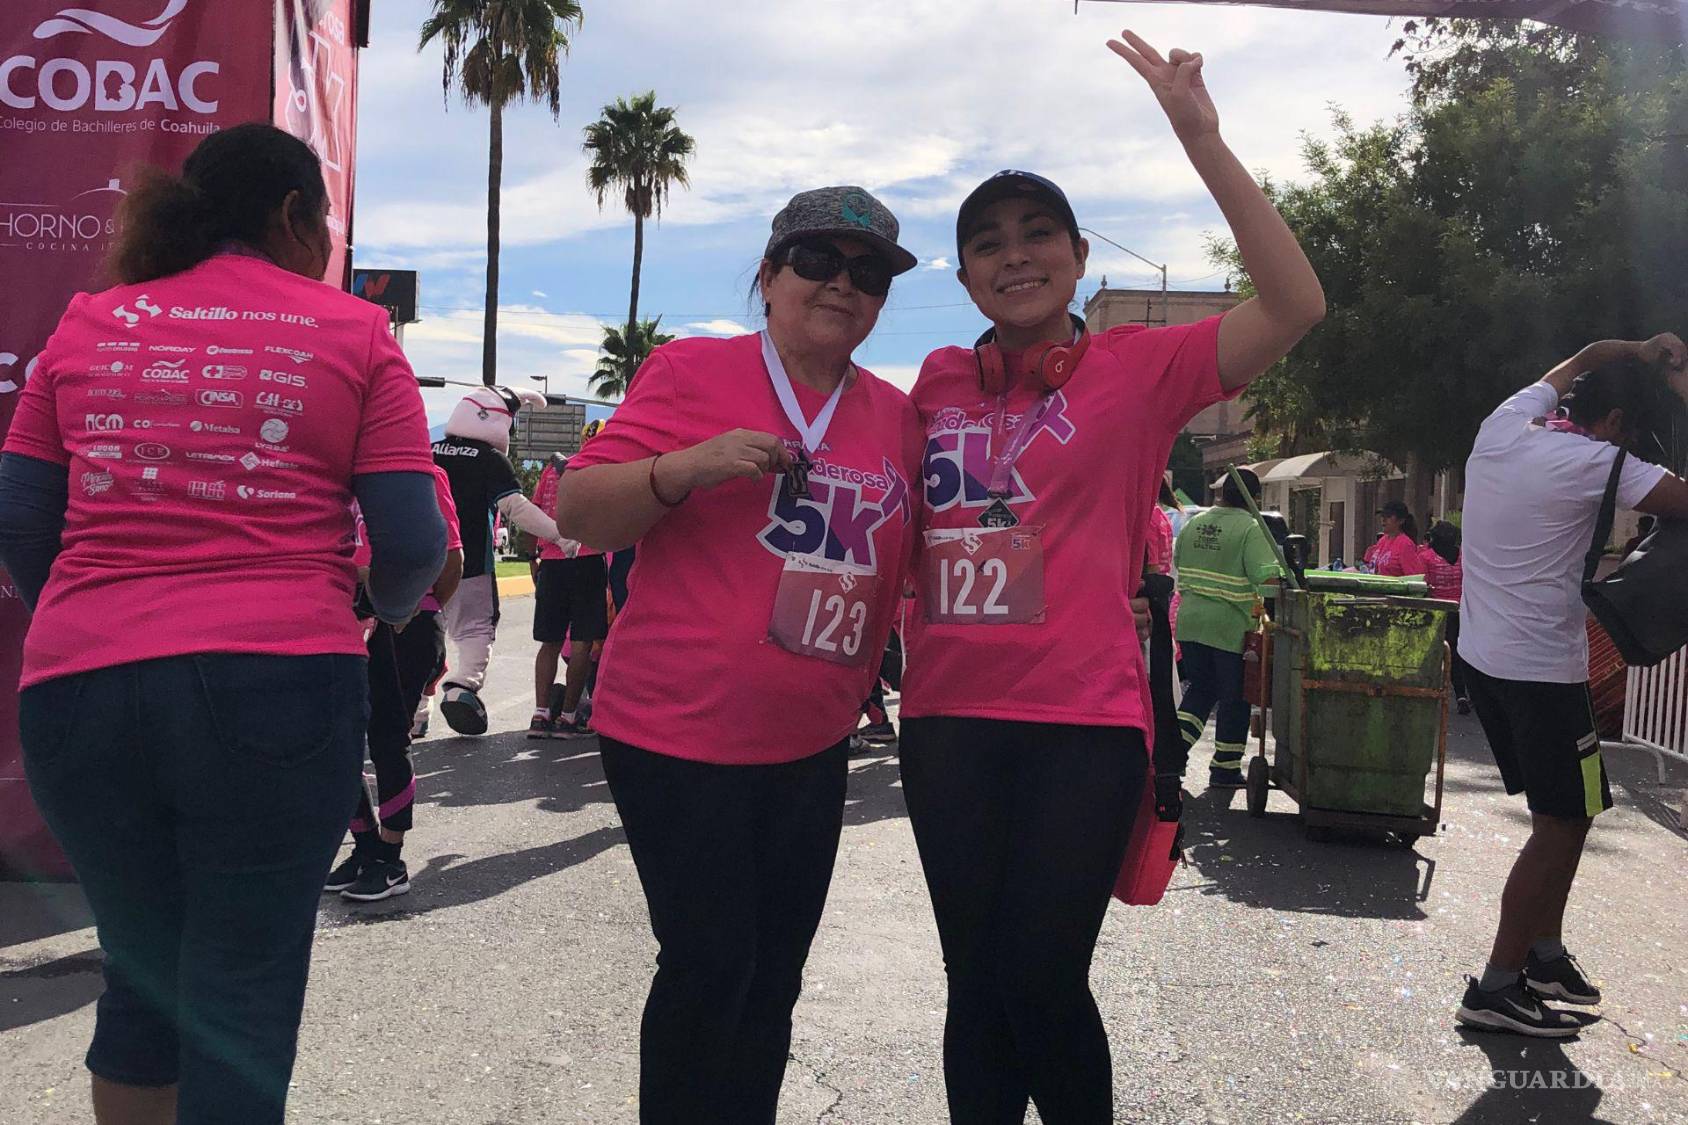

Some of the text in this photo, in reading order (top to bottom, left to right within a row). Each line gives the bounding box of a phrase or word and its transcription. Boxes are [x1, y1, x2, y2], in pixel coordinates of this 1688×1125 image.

[0, 55, 220, 113] COBAC
[51, 119, 68, 132] de
[72, 119, 137, 133] Bachilleres
[140, 118, 156, 131] de
[26, 242, 90, 251] COCINA
[168, 306, 319, 328] Saltillo nos une.
[431, 443, 480, 457] Alianza
[256, 489, 297, 499] Soriana
[756, 472, 888, 570] 5K
[939, 557, 1009, 616] 122
[801, 588, 867, 657] 123
